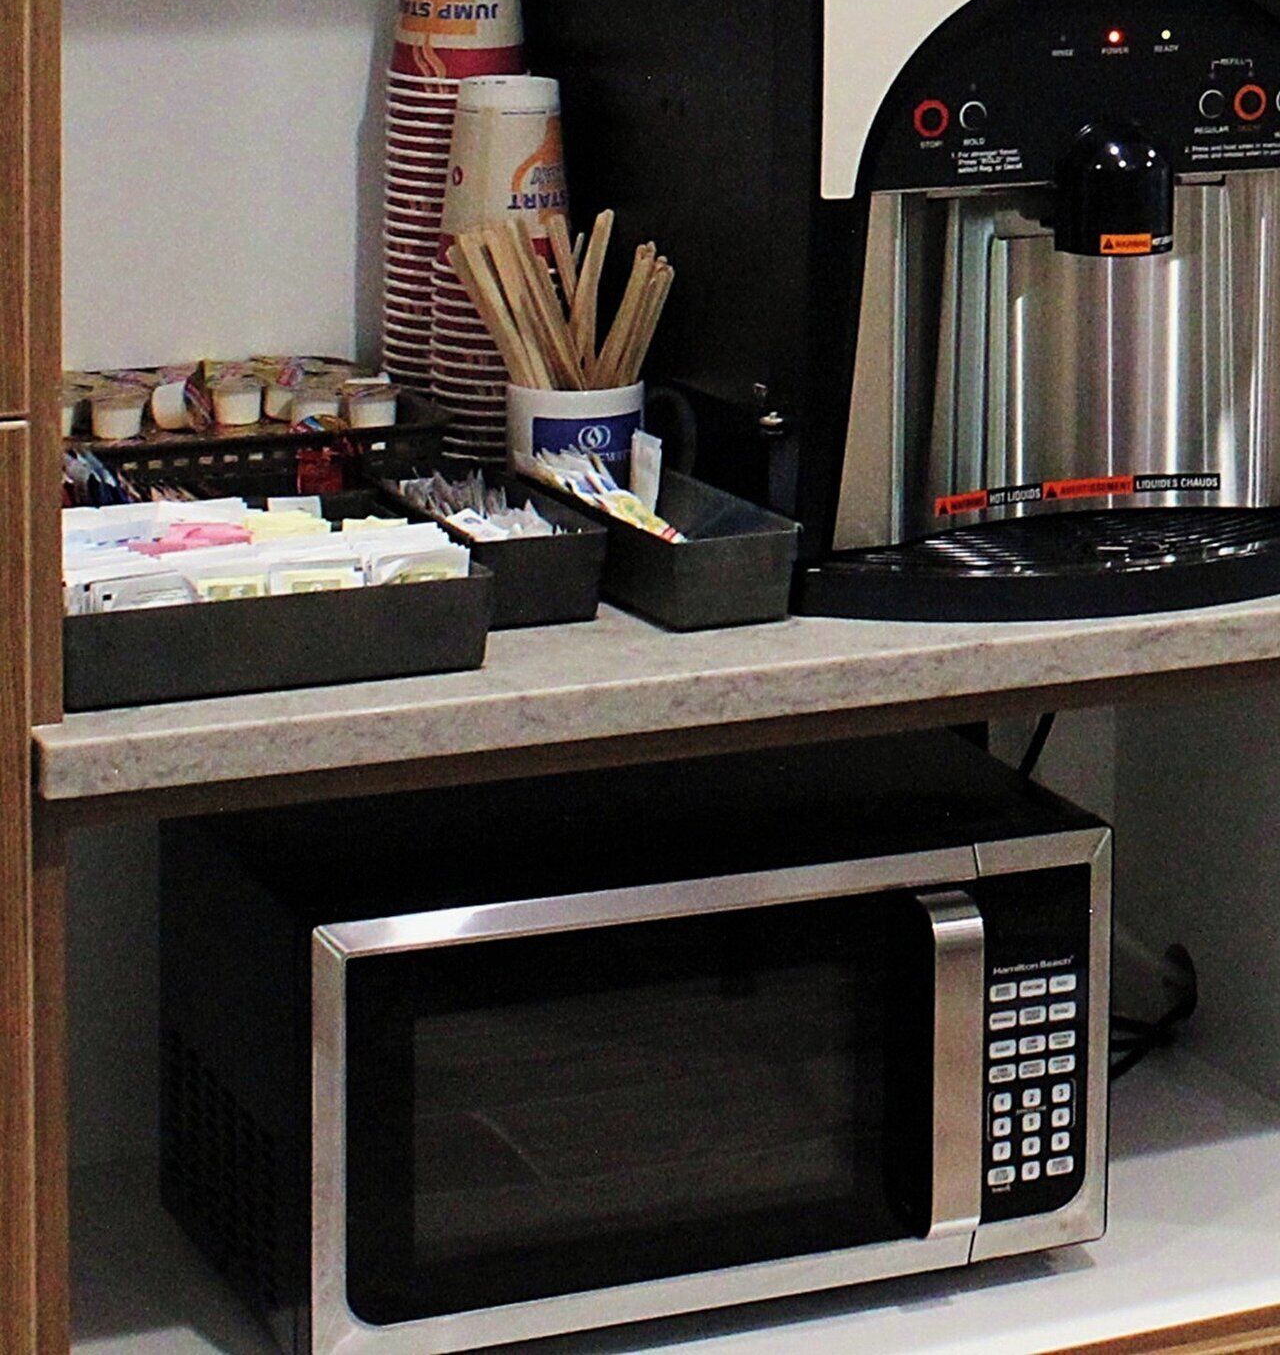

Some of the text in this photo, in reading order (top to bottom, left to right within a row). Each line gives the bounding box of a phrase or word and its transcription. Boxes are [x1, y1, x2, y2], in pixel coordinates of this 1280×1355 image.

[436, 3, 498, 21] JUMP
[1136, 477, 1178, 490] LIQUIDES
[1180, 476, 1219, 489] CHAUDS
[992, 958, 1072, 975] Hamilton Beach
